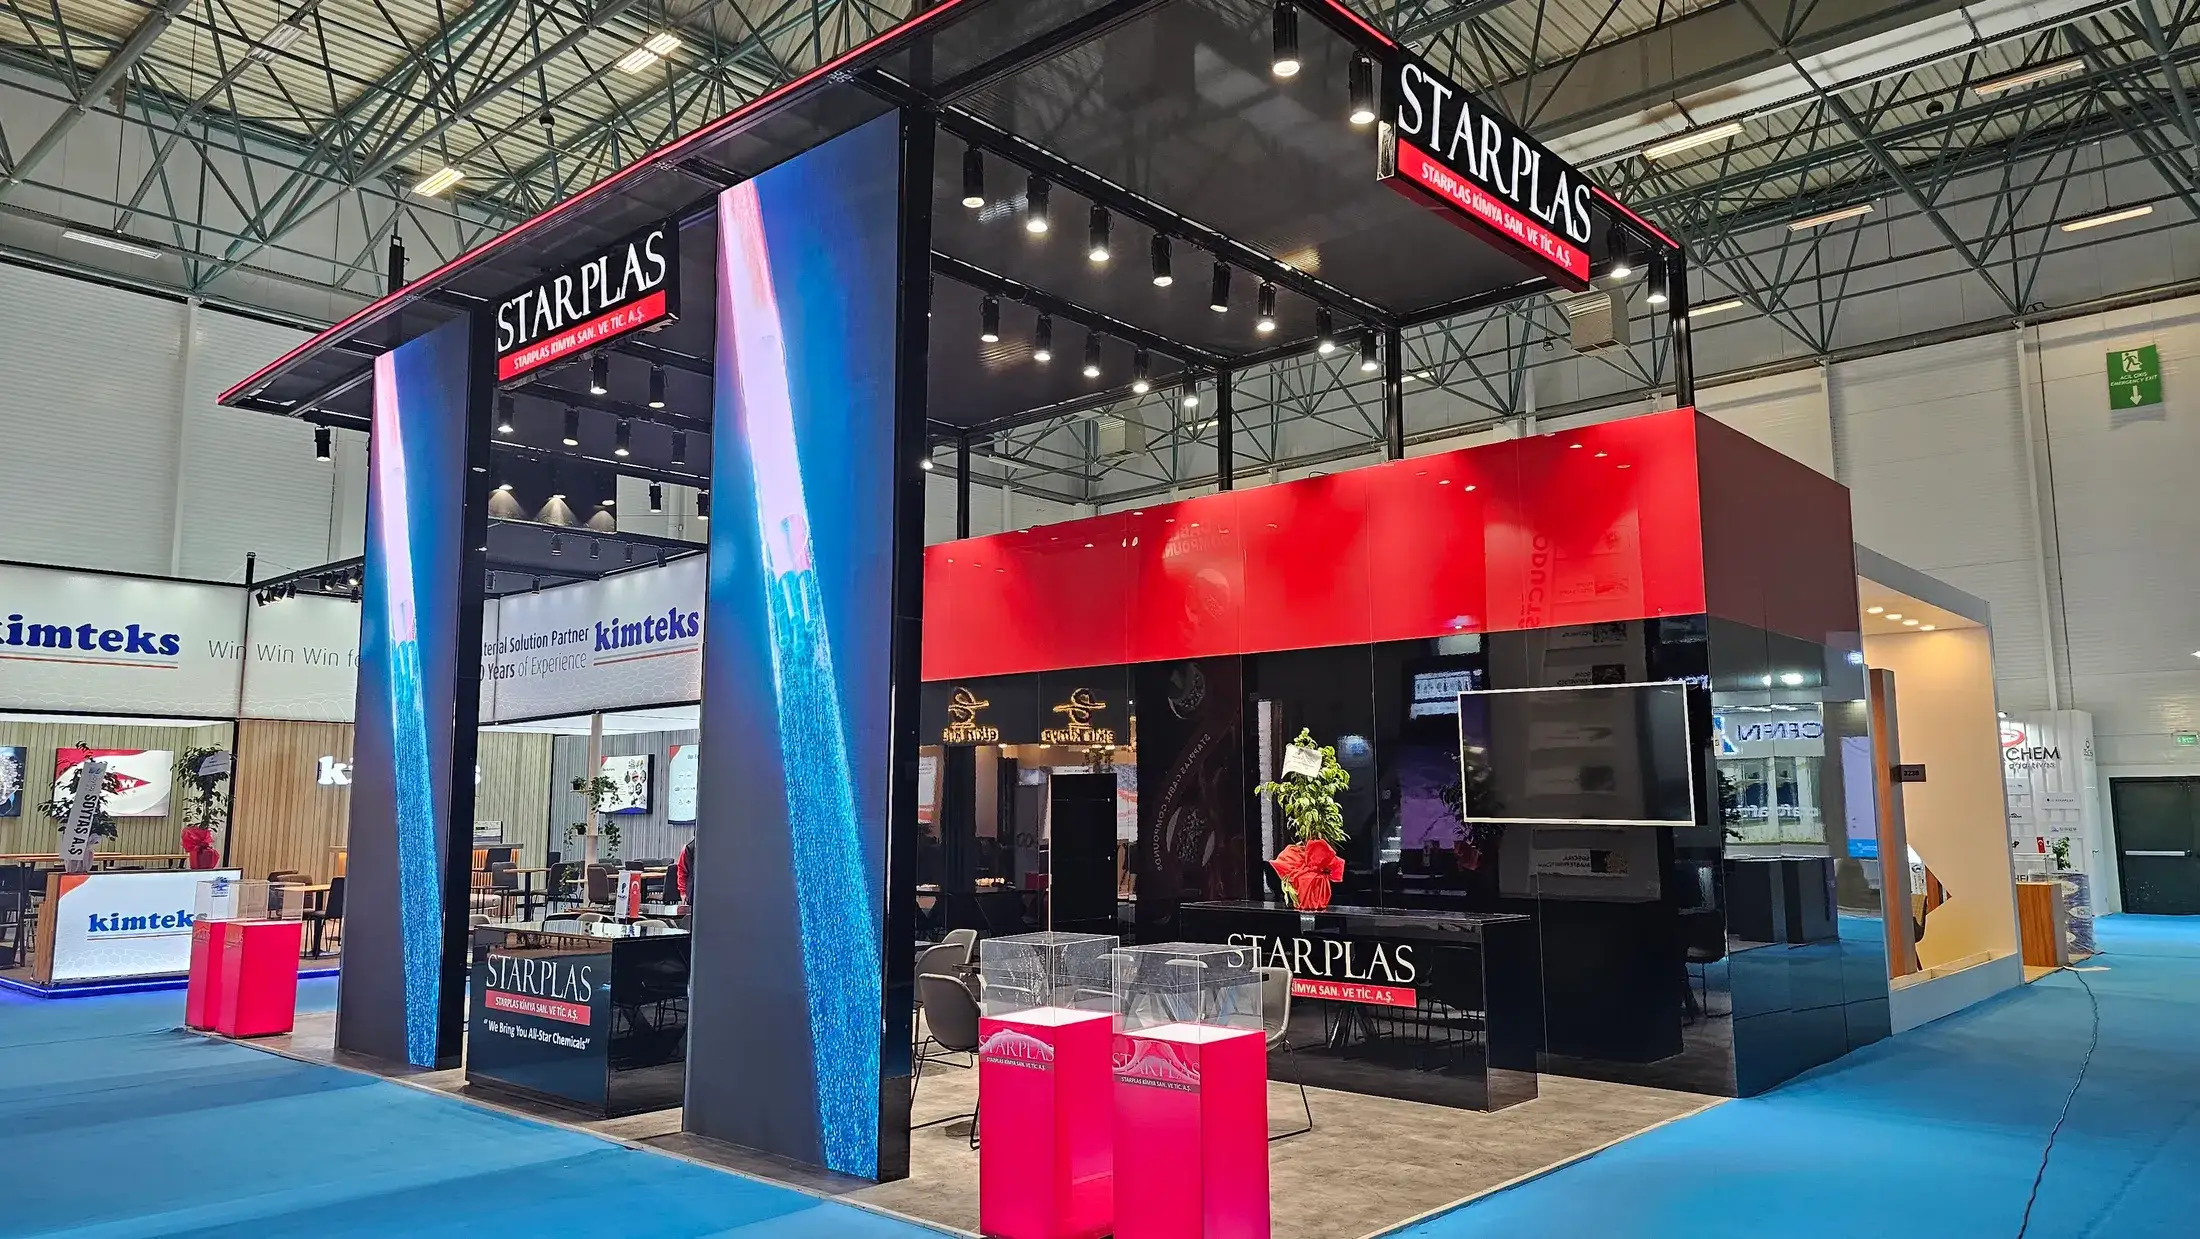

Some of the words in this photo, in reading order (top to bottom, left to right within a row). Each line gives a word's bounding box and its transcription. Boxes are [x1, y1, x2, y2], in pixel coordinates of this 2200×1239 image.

[1398, 63, 1591, 243] STARPLAS
[1421, 162, 1471, 205] STARPLAS
[1472, 192, 1503, 225] KİMYA
[1504, 213, 1526, 238] SAN.
[1527, 226, 1538, 246] VE
[1539, 232, 1555, 256] TİC.
[1556, 245, 1572, 267] A.Ş.
[497, 230, 667, 353] STARPLAS
[513, 345, 550, 370] STARPLAS
[551, 338, 576, 355] KİMYA
[577, 328, 597, 344] SAN.
[598, 320, 609, 335] VE
[610, 313, 627, 330] TİC.
[628, 306, 645, 323] A.Ş.
[0, 614, 180, 656] imteks
[481, 636, 507, 656] terial
[510, 632, 548, 653] Solution
[551, 628, 589, 646] Partner
[594, 607, 699, 652] kimteks
[208, 639, 247, 660] Win
[257, 643, 294, 663] Win
[303, 646, 339, 666] Win
[488, 663, 515, 680] Years
[518, 656, 529, 677] of
[531, 652, 587, 679] Experience
[2004, 746, 2060, 761] CHEM
[1227, 933, 1416, 983] STARPLAS
[485, 953, 593, 1002] STARPLAS
[1318, 985, 1340, 997] SAN.
[1342, 987, 1354, 998] VE
[1356, 986, 1374, 1000] TİC.
[1376, 991, 1394, 1004] A.Ş.
[495, 996, 519, 1009] STARPLAS
[520, 999, 536, 1012] KİMYA
[536, 1004, 548, 1014] SAN.
[549, 1005, 556, 1016] VE
[556, 1005, 566, 1018] TİC.
[567, 1008, 578, 1021] A.Ş.
[488, 1020, 499, 1032] We
[499, 1022, 515, 1037] Bring
[515, 1025, 527, 1038] You
[528, 1027, 552, 1043] All-Star
[1121, 1076, 1142, 1085] STARPLAS
